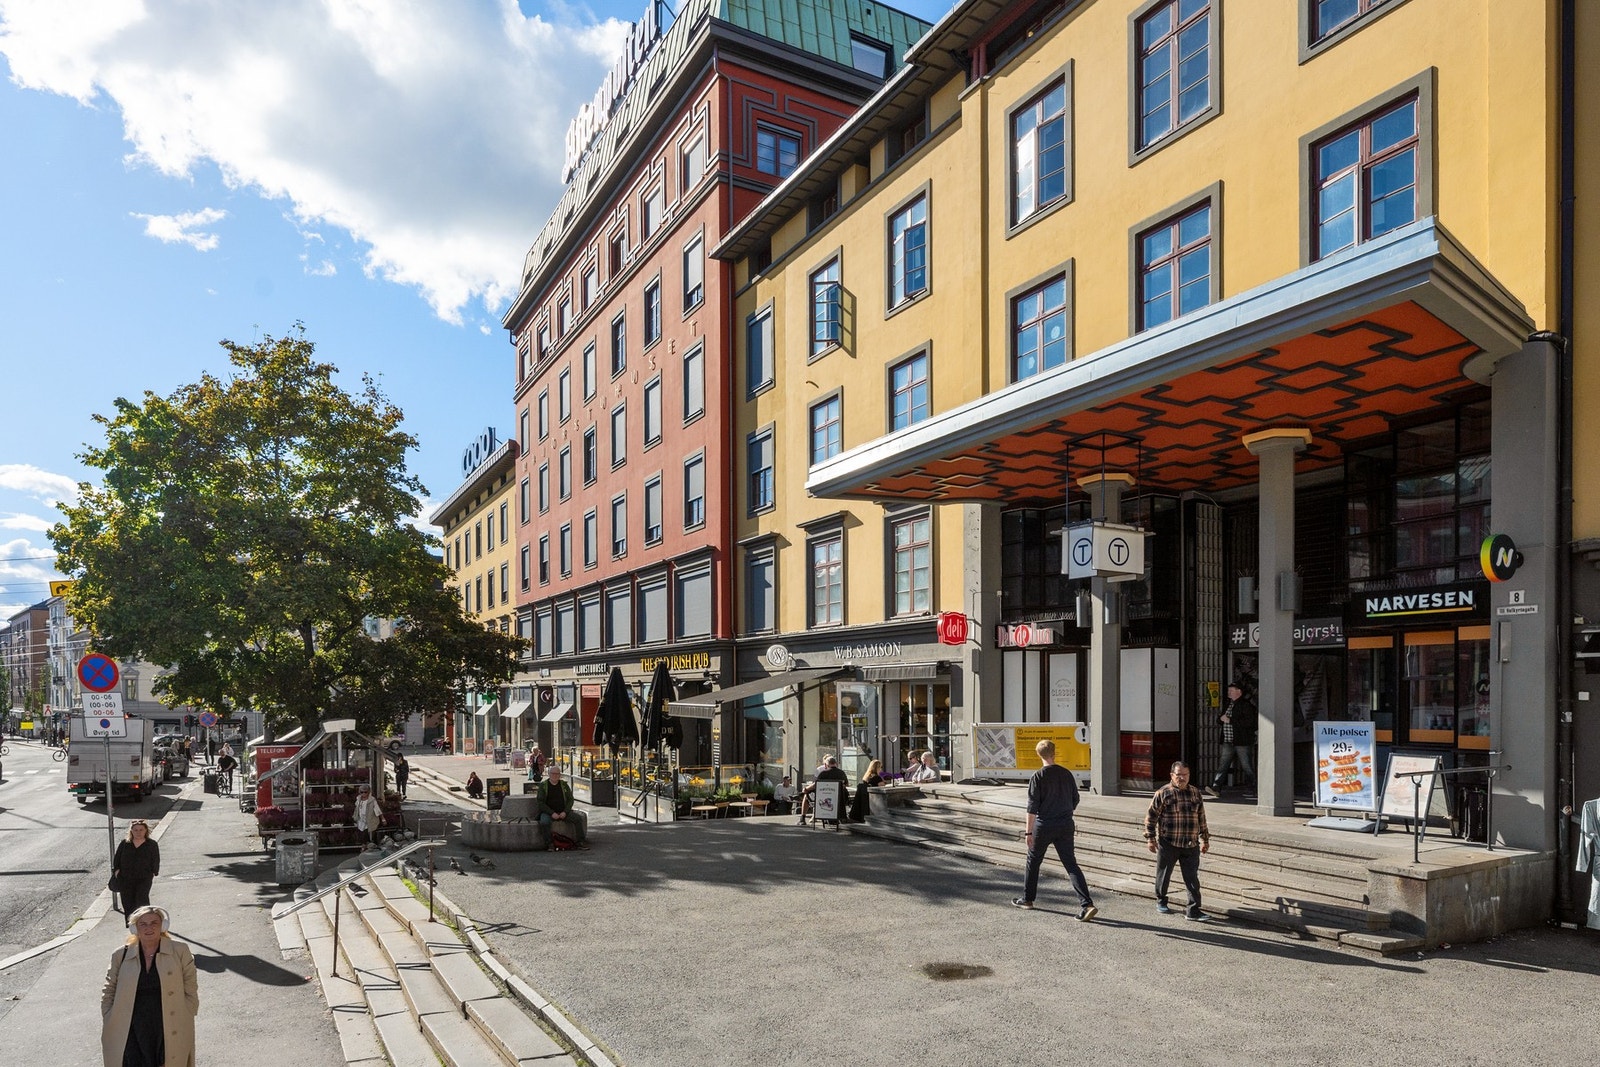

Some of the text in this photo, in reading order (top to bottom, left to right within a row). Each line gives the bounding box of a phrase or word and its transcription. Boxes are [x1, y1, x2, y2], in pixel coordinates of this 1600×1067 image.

[1078, 544, 1089, 562] T
[1114, 544, 1124, 562] T
[1496, 547, 1514, 568] N
[1366, 590, 1473, 612] NARVESEN
[1514, 592, 1520, 603] 8
[946, 618, 963, 638] deli
[857, 641, 901, 658] SAMSON
[641, 658, 654, 671] THE
[670, 654, 691, 670] IRISH
[693, 652, 709, 668] PUB
[1321, 727, 1338, 735] Alle
